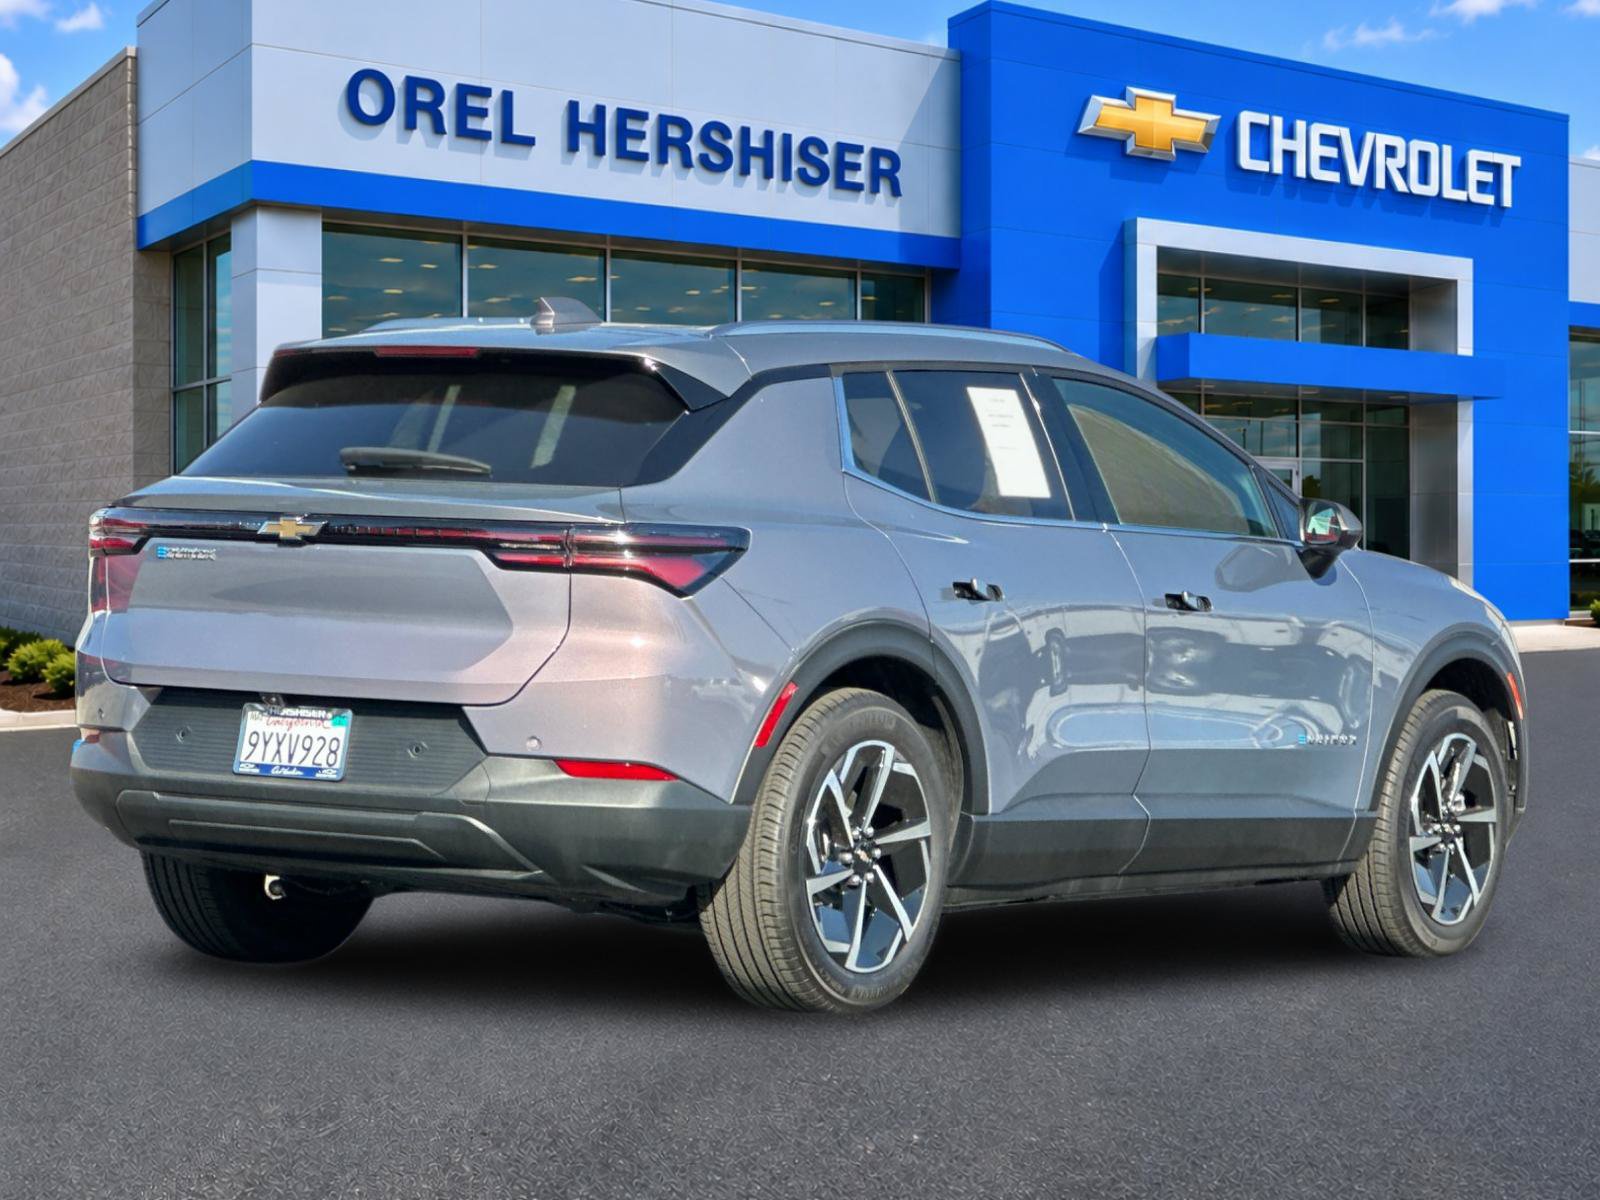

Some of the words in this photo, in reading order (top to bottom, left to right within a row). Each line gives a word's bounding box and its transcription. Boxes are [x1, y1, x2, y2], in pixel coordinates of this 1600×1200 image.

[346, 68, 535, 147] OREL
[567, 99, 902, 197] HERSHISER
[1236, 110, 1521, 208] CHEVROLET
[244, 730, 340, 767] 9YXV928
